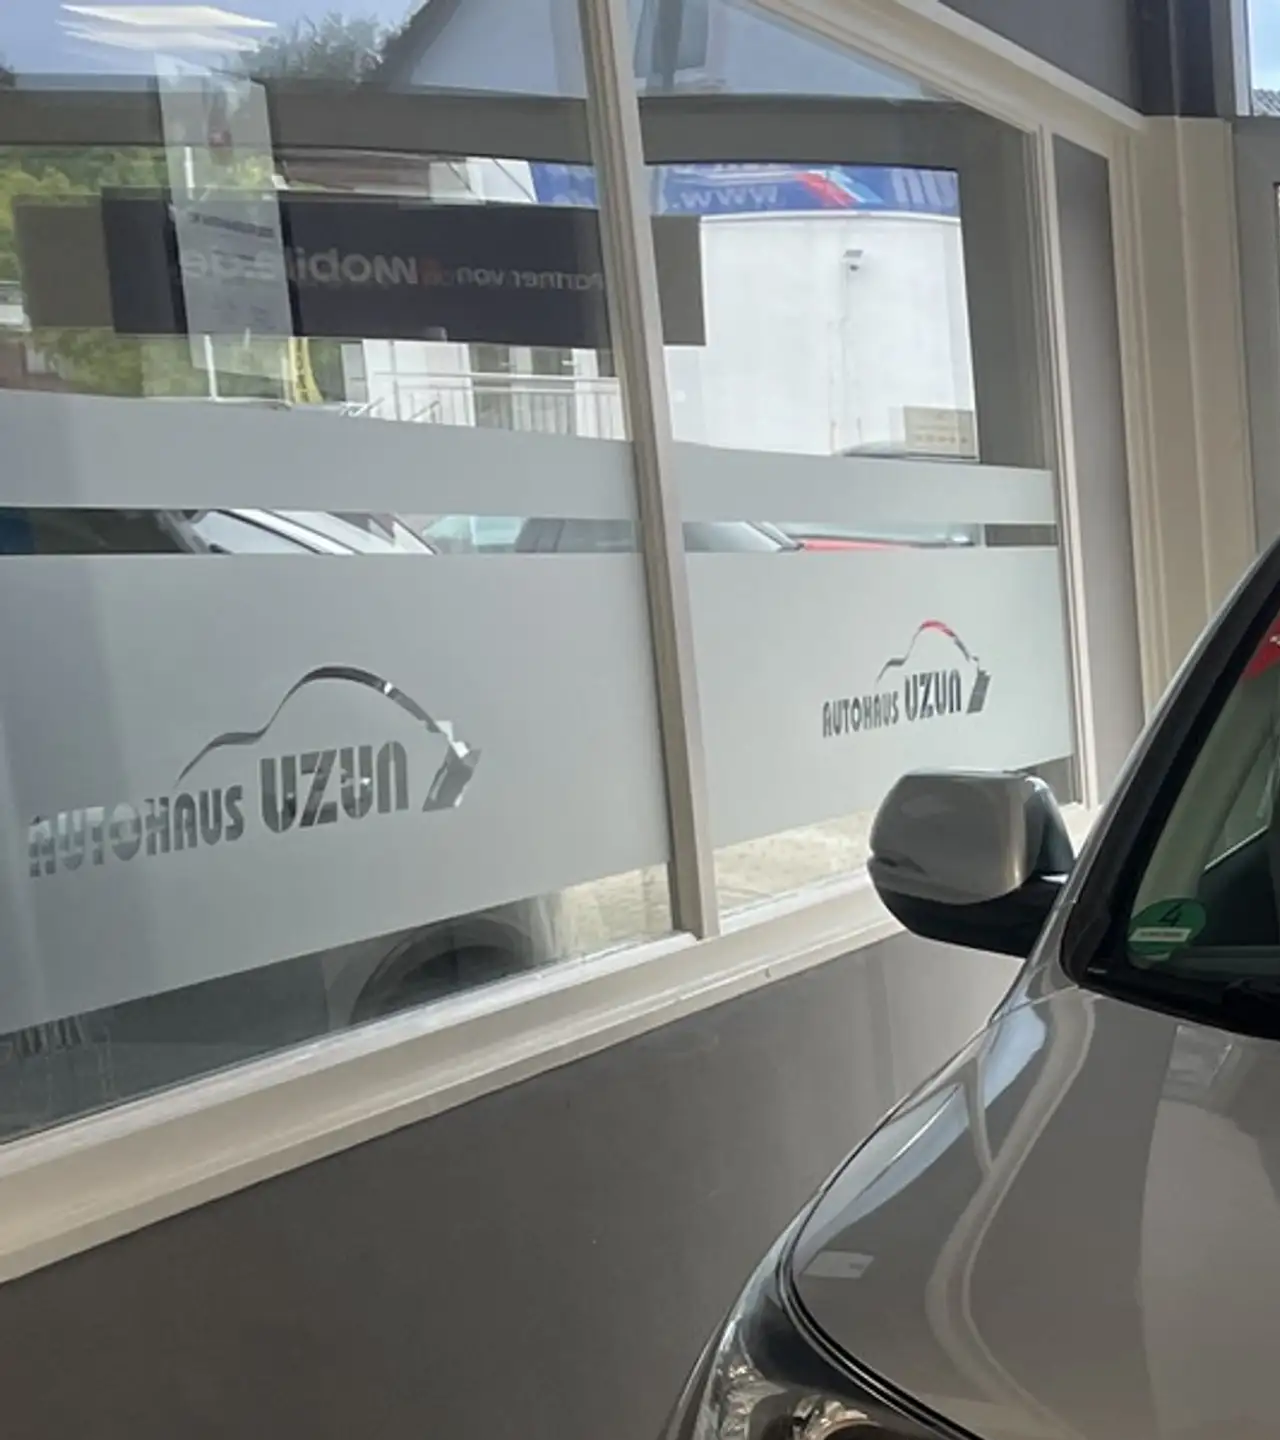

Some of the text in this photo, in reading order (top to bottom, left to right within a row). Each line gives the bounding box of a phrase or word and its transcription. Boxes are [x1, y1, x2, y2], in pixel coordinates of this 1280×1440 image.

[822, 668, 962, 739] AUTOHAUS UZUN
[28, 740, 409, 878] AUTOHAUS UZUN
[1158, 901, 1183, 929] 4
